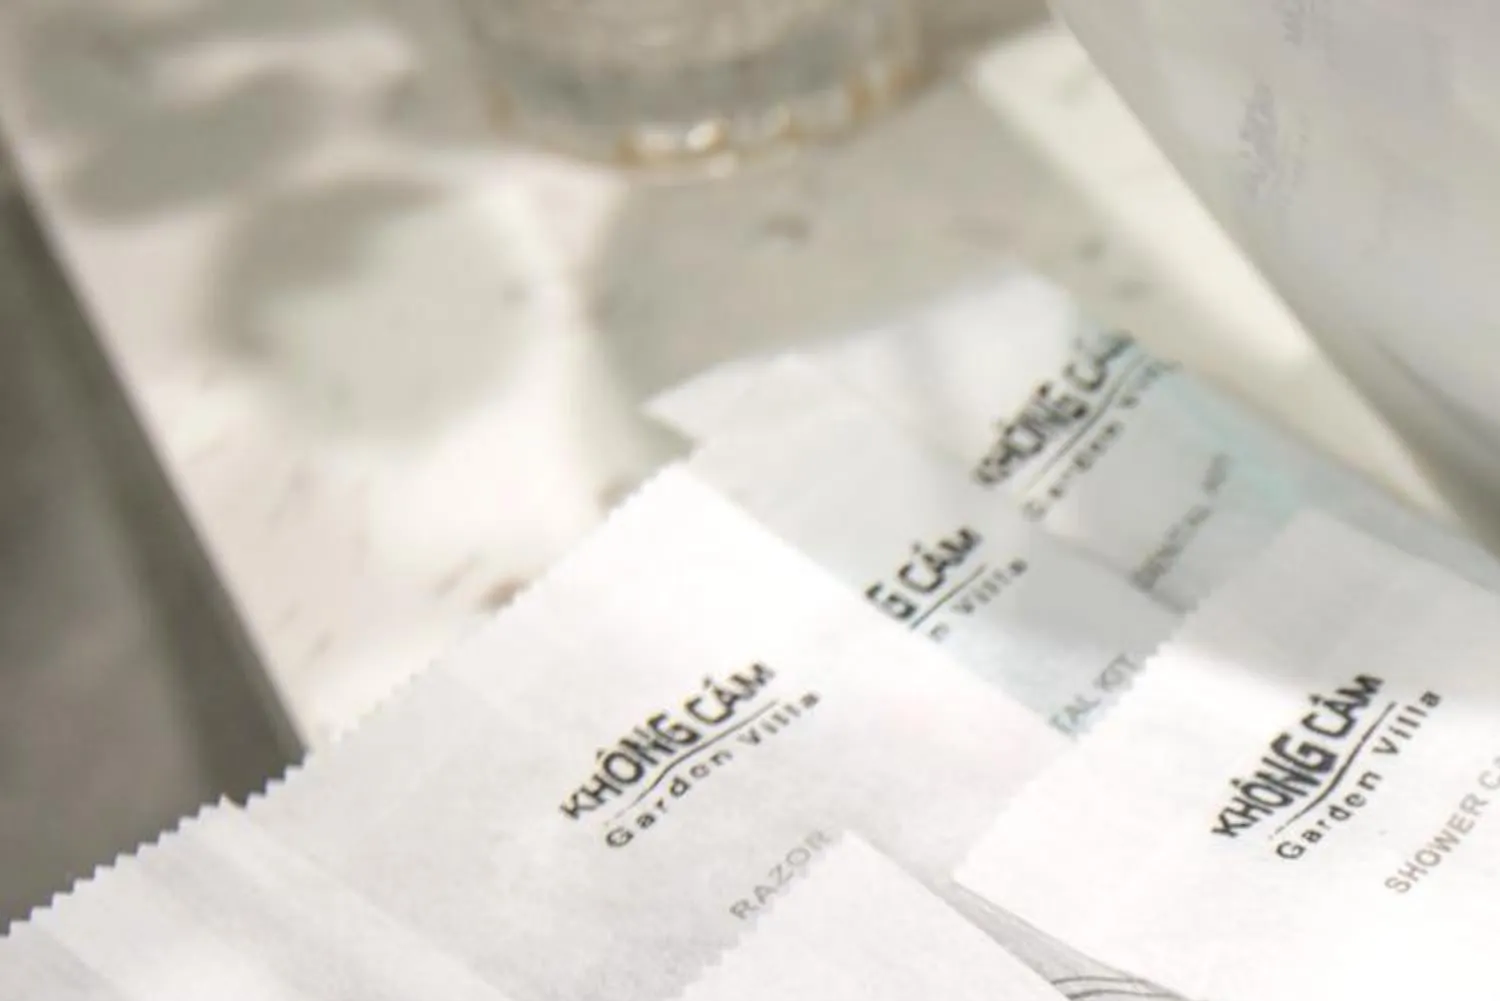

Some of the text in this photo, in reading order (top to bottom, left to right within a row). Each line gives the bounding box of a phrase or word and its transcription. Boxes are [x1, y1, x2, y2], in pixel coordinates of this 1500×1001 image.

[559, 711, 701, 820] KHÔNG
[605, 692, 821, 850] Garden Villa
[1211, 732, 1338, 840] KHÔNG
[1275, 689, 1443, 861] Garden Villa
[729, 829, 832, 921] RAZOR
[1384, 791, 1490, 894] SHOWER
